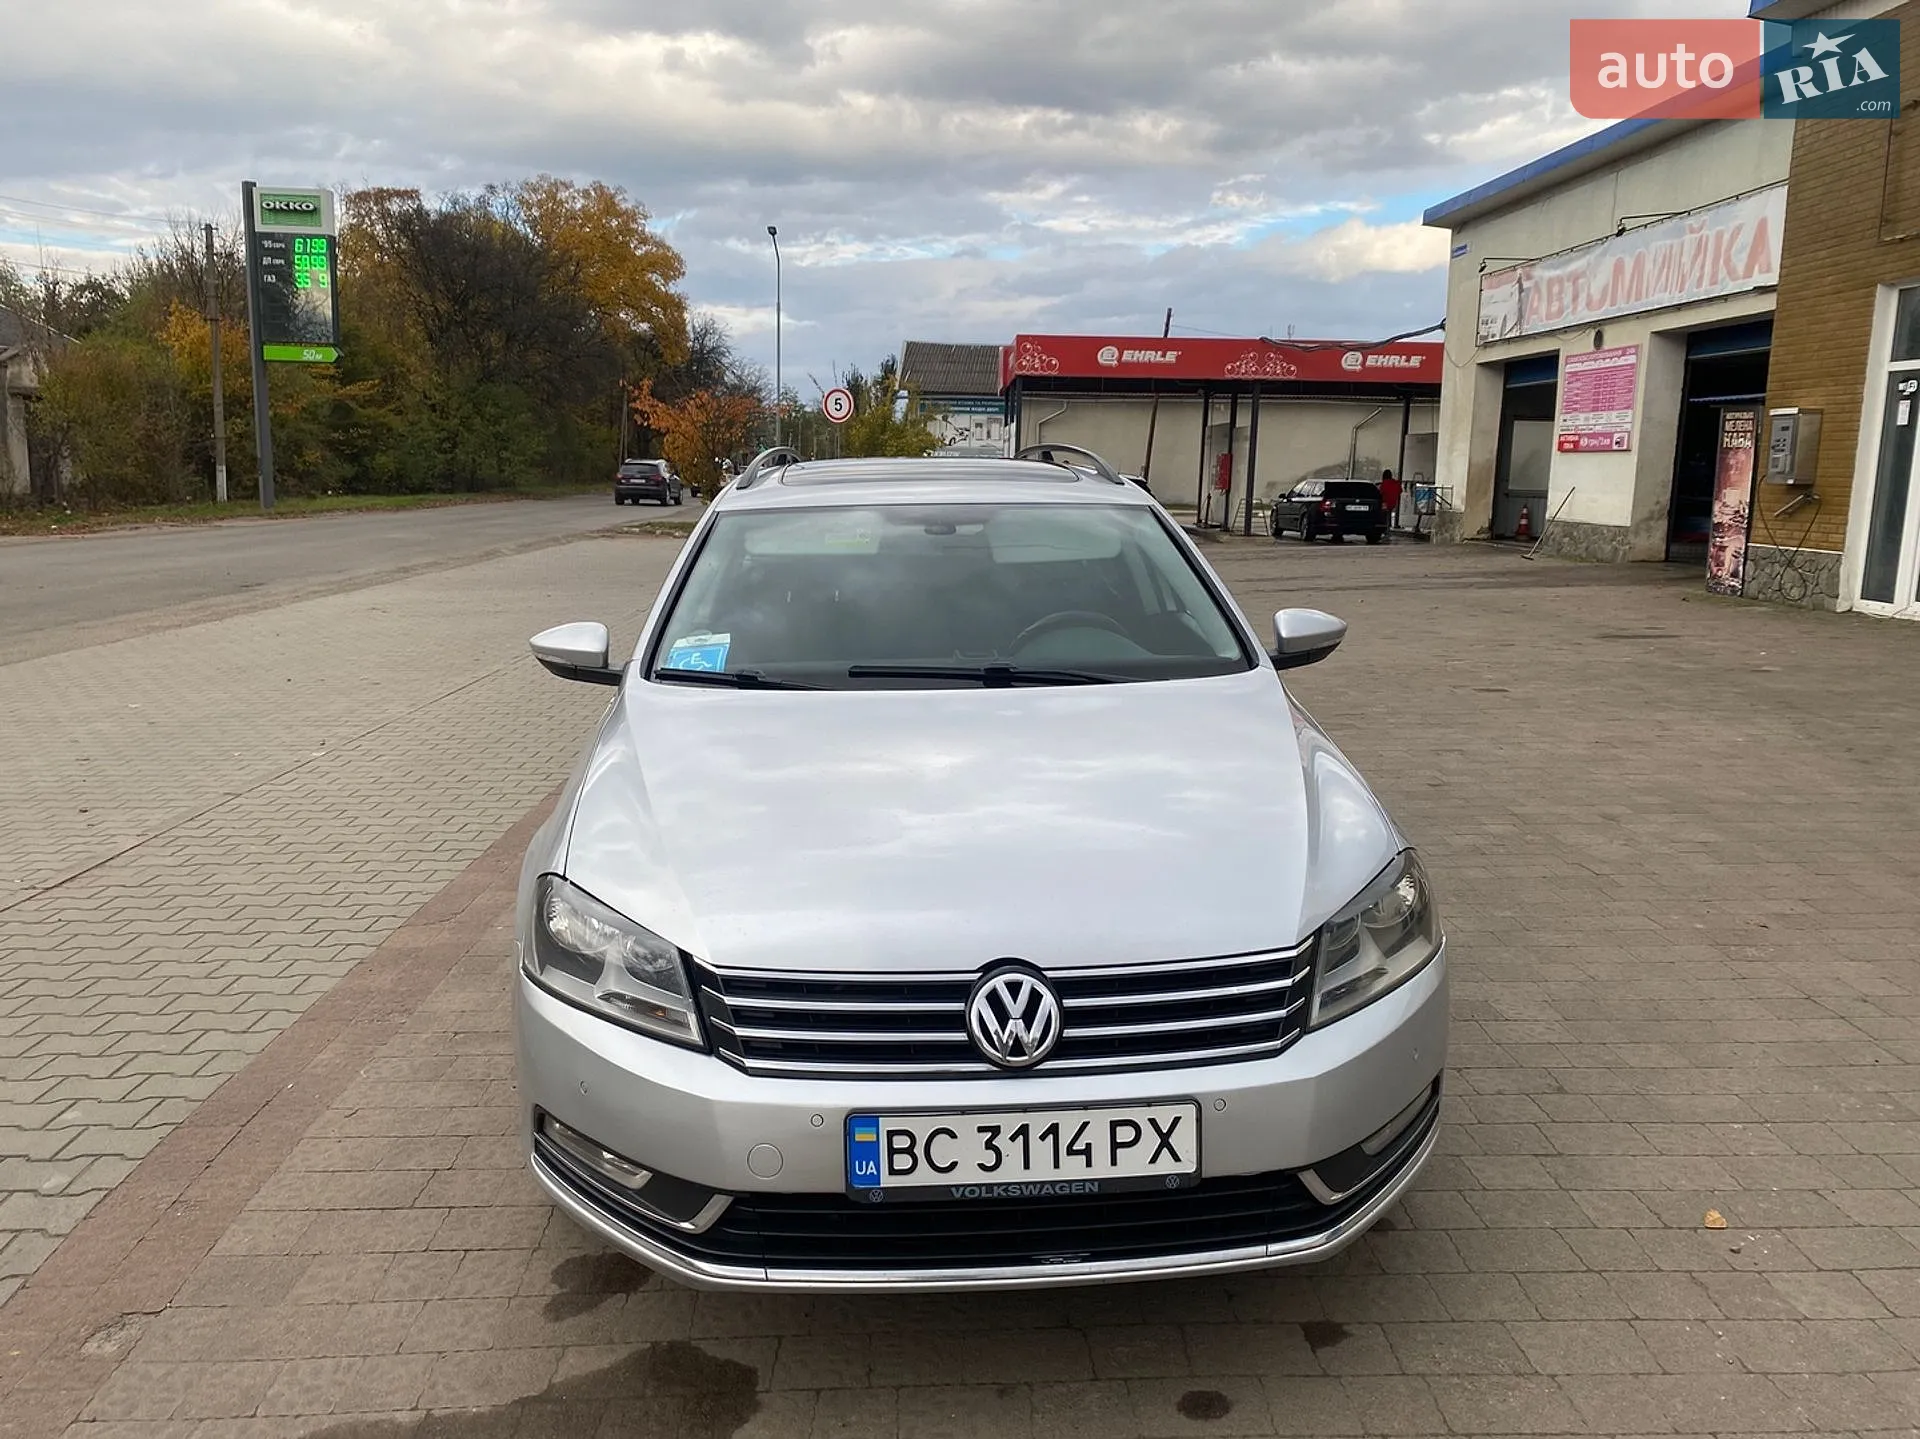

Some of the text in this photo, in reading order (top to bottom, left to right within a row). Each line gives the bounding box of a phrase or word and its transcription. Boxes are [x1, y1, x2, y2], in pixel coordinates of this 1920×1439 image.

[262, 201, 314, 211] OKKO
[1121, 349, 1178, 363] EHRLE
[1365, 354, 1422, 368] EHRLE
[834, 398, 843, 411] 5
[886, 1115, 1182, 1176] BC 3114 PX
[855, 1160, 877, 1175] UA
[951, 1181, 1099, 1199] VOLKSWAGEN
